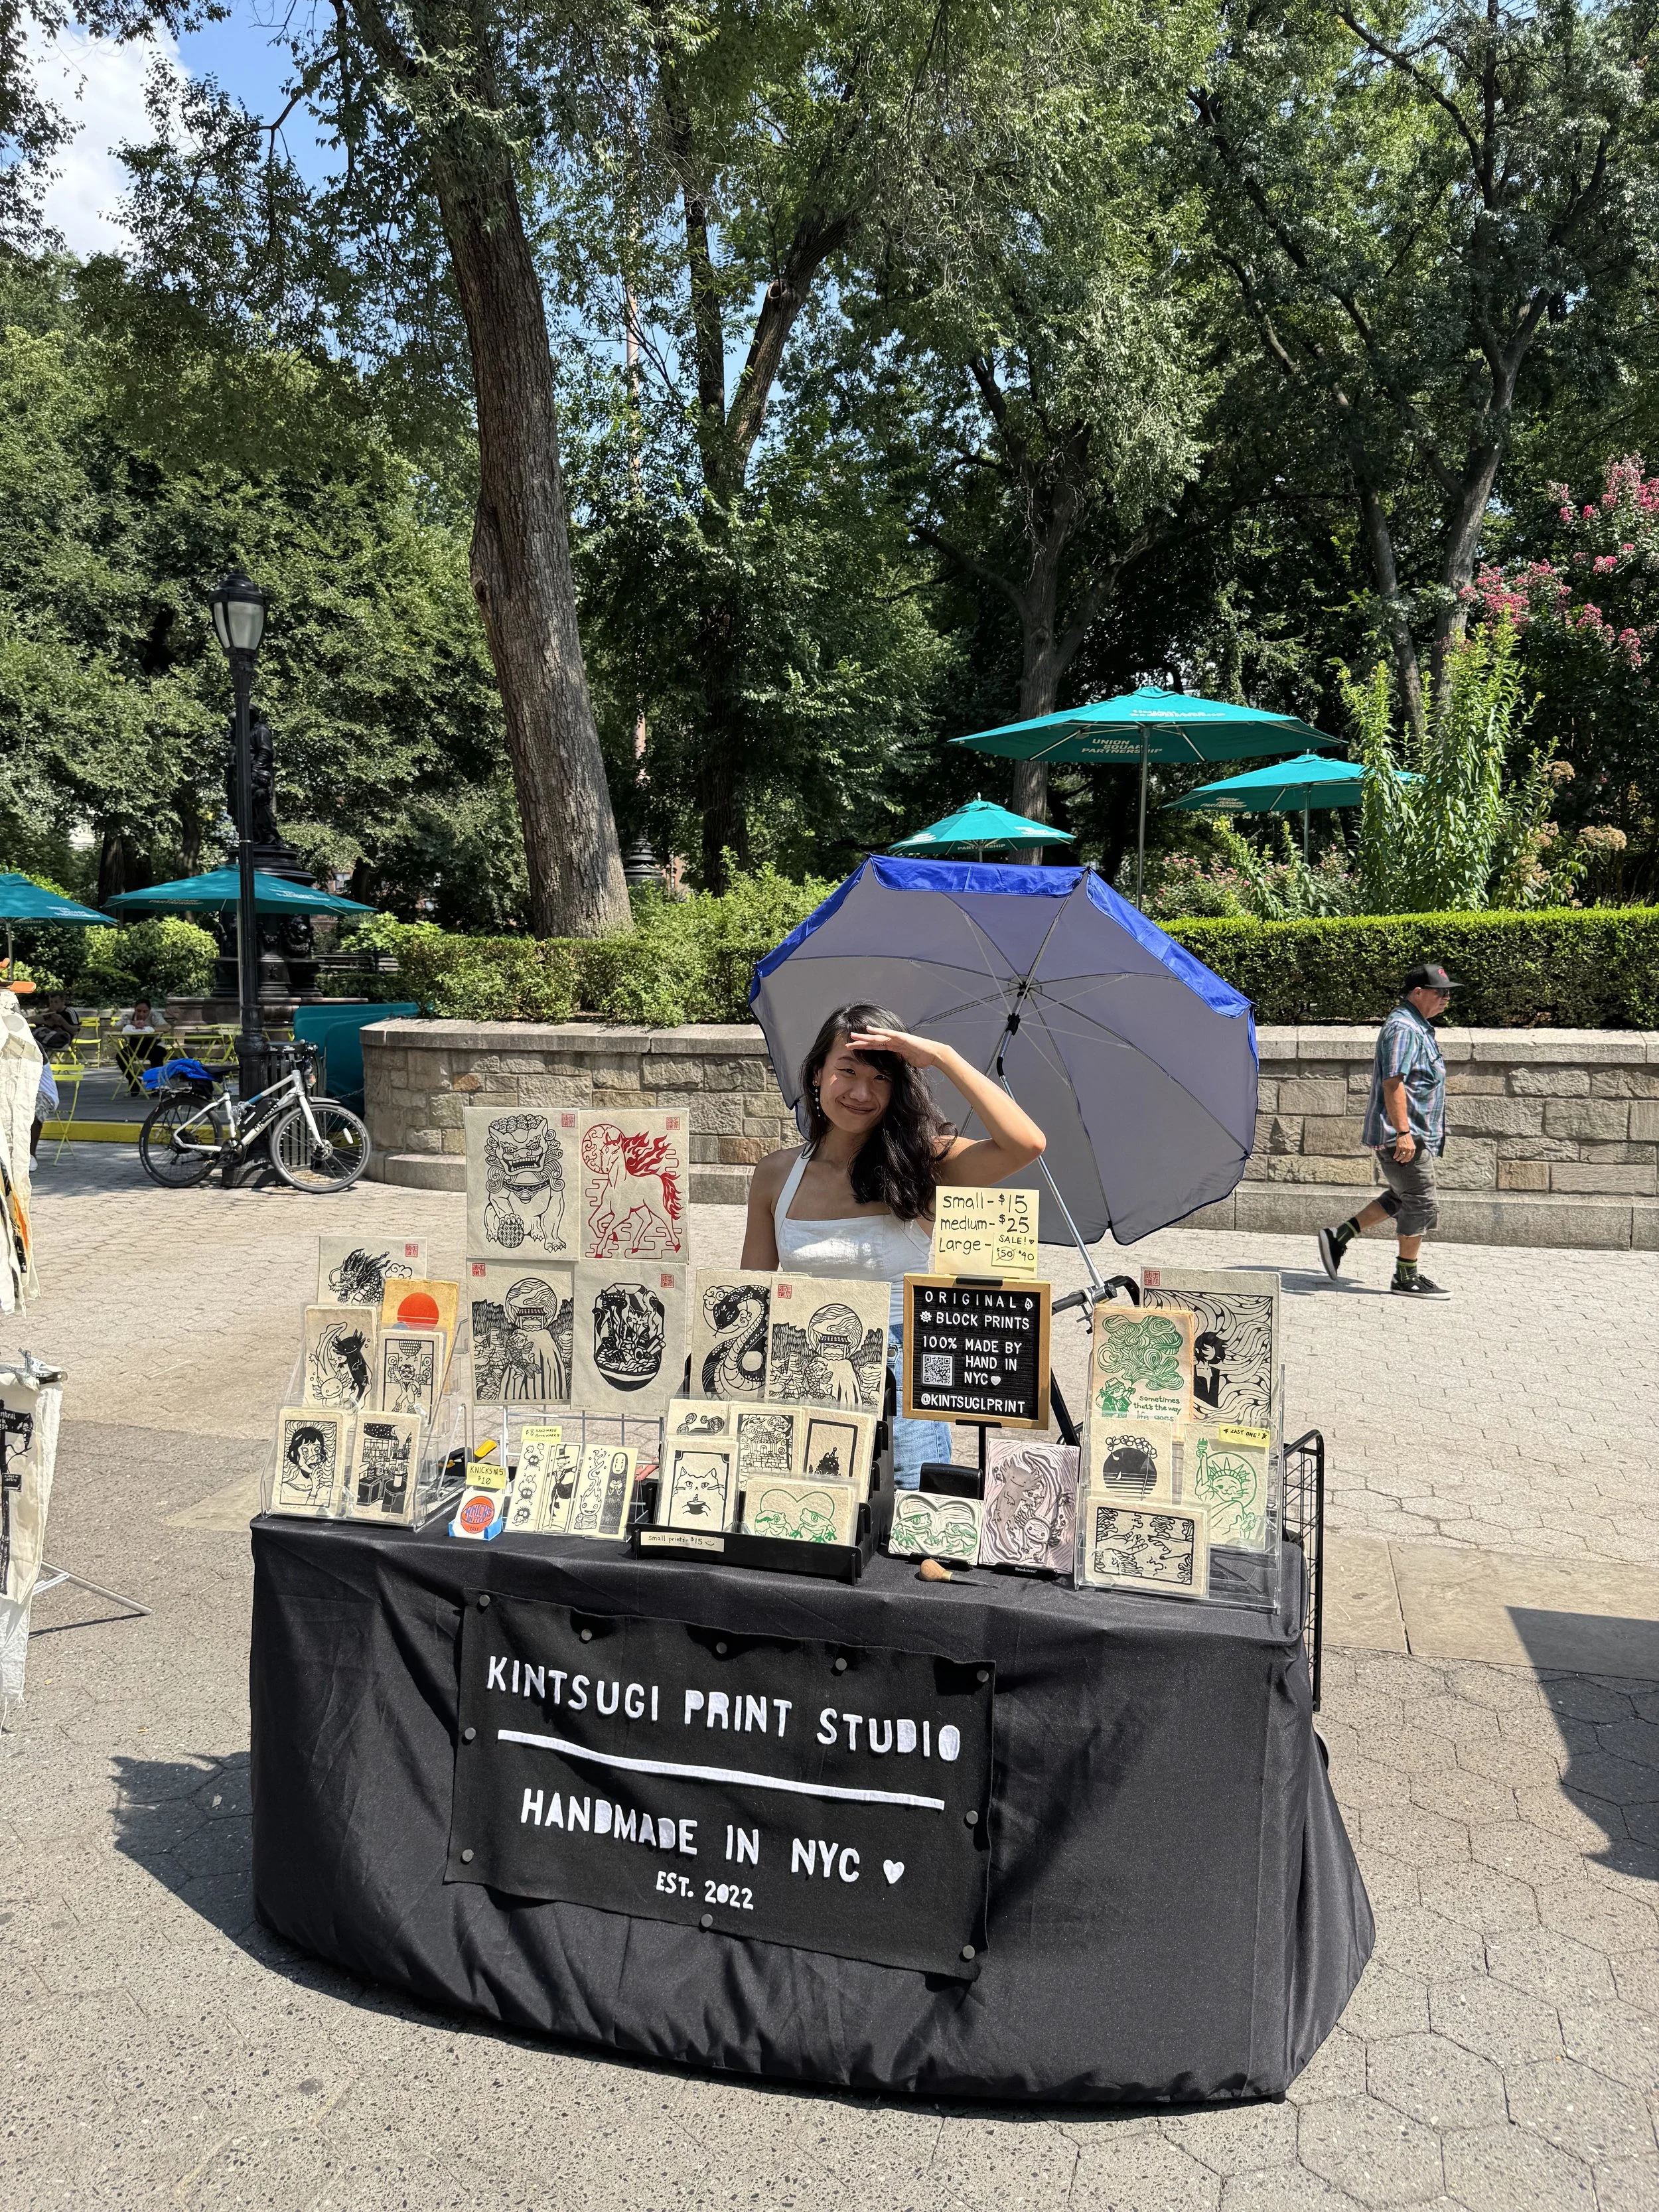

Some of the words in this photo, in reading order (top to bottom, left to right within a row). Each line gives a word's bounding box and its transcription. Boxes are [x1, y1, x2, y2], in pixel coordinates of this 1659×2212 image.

[998, 1193, 1028, 1213] $15
[999, 1213, 1029, 1234] $25
[998, 1234, 1027, 1245] SALE!
[1019, 1250, 1035, 1261] $40
[924, 1290, 1017, 1309] ORIGINAL
[936, 1311, 978, 1327] BLOCK
[984, 1315, 1030, 1330] PRINTS
[922, 1335, 958, 1349] 100%
[965, 1338, 999, 1353] MADE
[1005, 1341, 1023, 1355] BY
[966, 1355, 997, 1370] HAND
[1005, 1358, 1017, 1372] IN
[964, 1371, 989, 1386] NYC
[920, 1392, 1026, 1414] @KINTSUGI.PRINT
[1139, 1395, 1181, 1404] sometimes
[0, 1411, 17, 1420] ntral
[1137, 1410, 1149, 1420] life
[1167, 1406, 1182, 1415] way
[470, 1466, 492, 1475] KNICKS
[478, 1475, 491, 1485] $10
[465, 1505, 492, 1517] KNICKS
[690, 1536, 703, 1545] $15
[486, 1655, 658, 1722] KINTSUGI
[684, 1689, 792, 1737] PRINT
[816, 1708, 960, 1761] STUDIO
[521, 1788, 698, 1856] HANDMADE
[725, 1824, 759, 1865] IN
[790, 1838, 861, 1883] NYC
[655, 1870, 694, 1898] EST.
[704, 1880, 755, 1911] 2022
